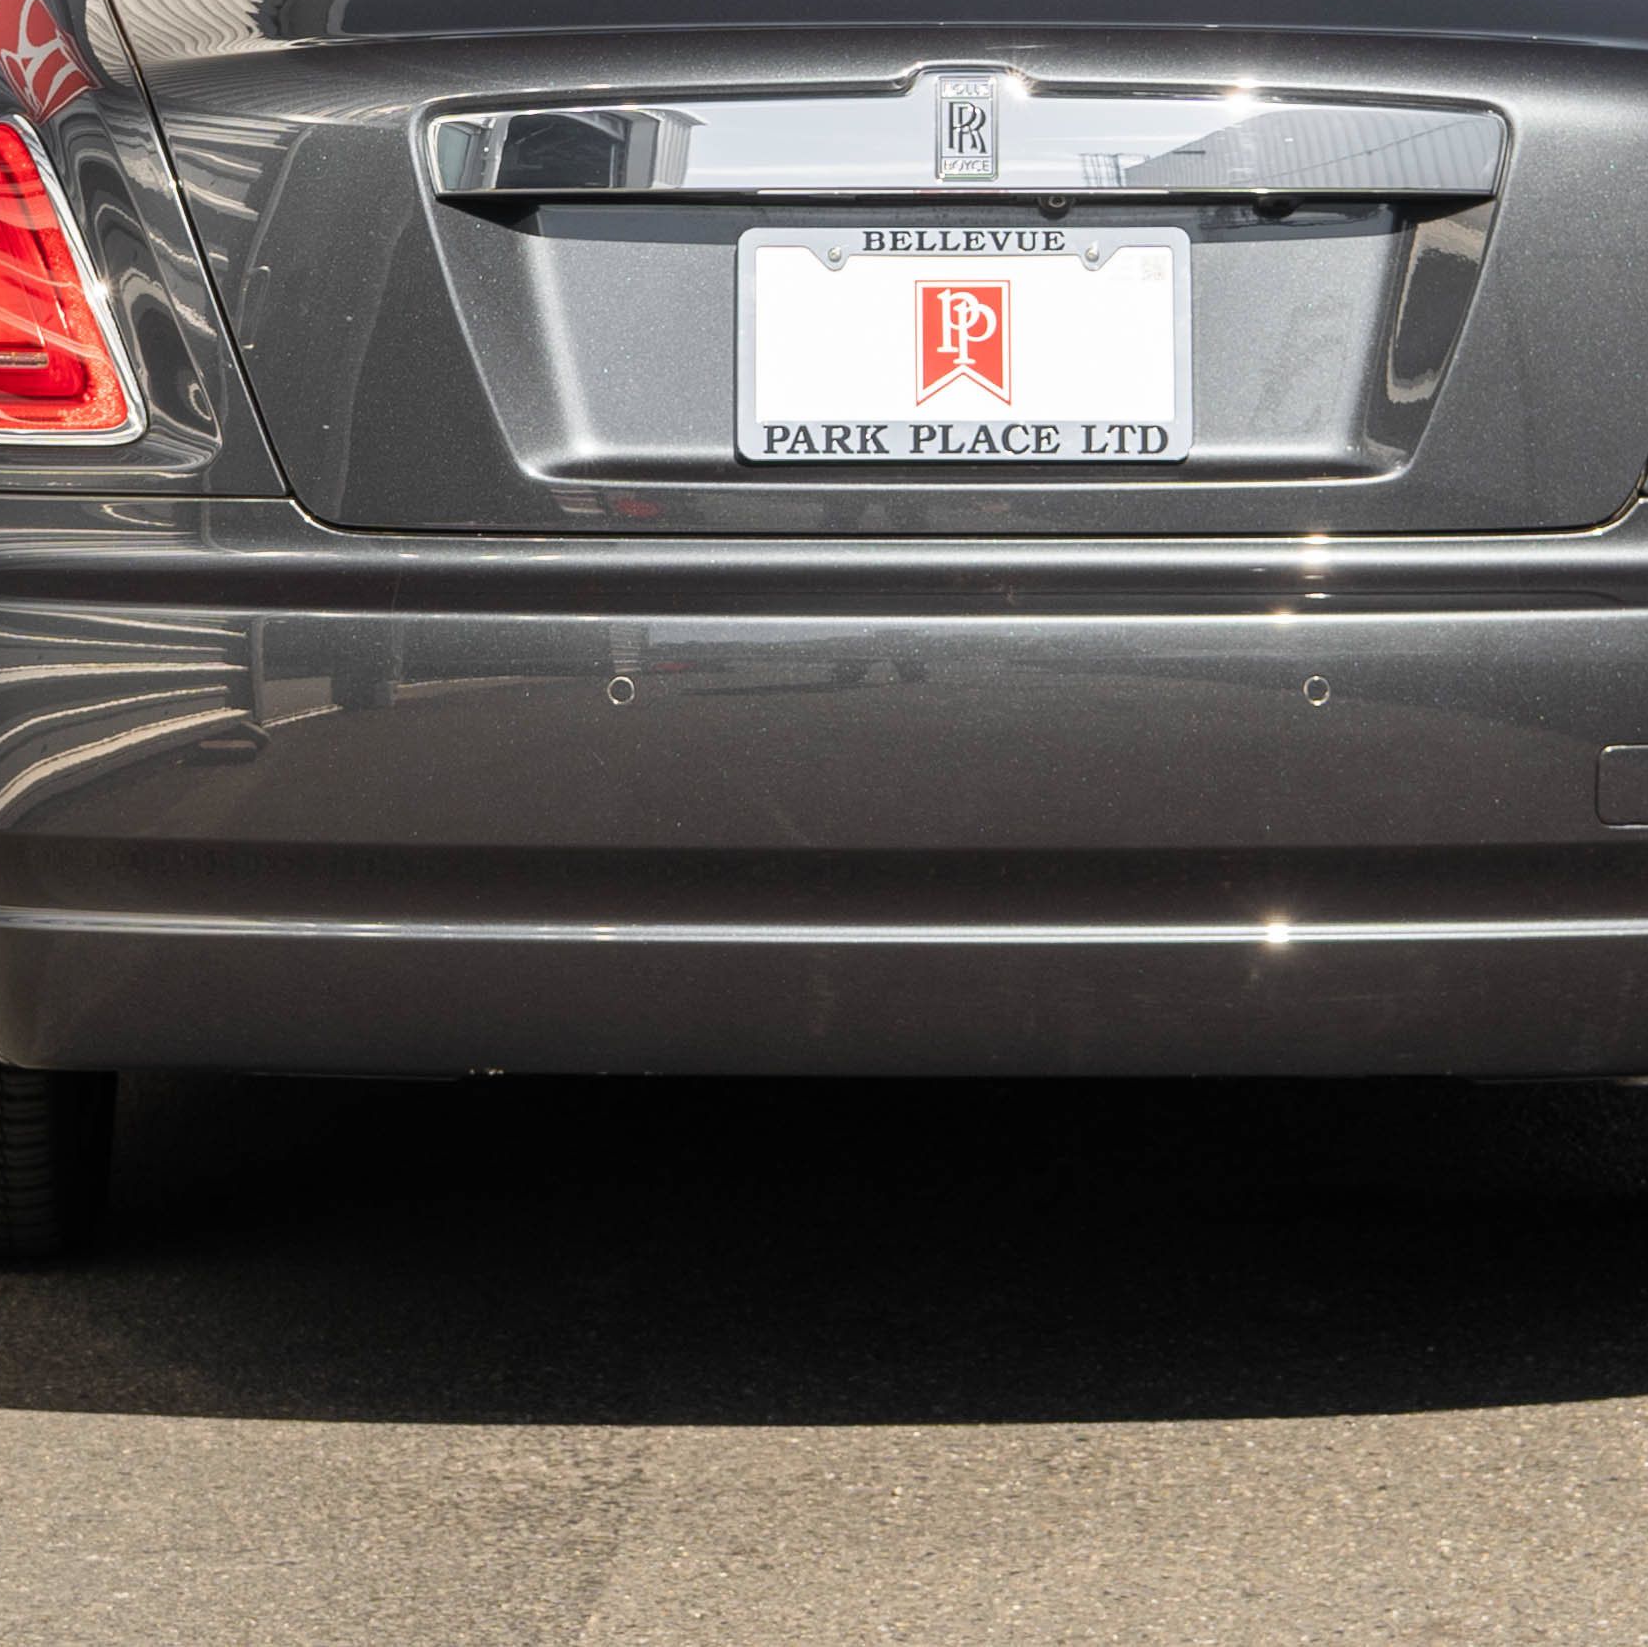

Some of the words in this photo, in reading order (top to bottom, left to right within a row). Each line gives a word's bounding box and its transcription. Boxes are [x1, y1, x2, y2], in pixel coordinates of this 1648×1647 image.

[947, 100, 987, 154] RR
[943, 159, 991, 172] ROYCE
[862, 230, 1066, 252] BELLEVUE
[763, 423, 890, 455] PARK
[909, 423, 1061, 455] PLACE
[1080, 423, 1170, 455] LTD
